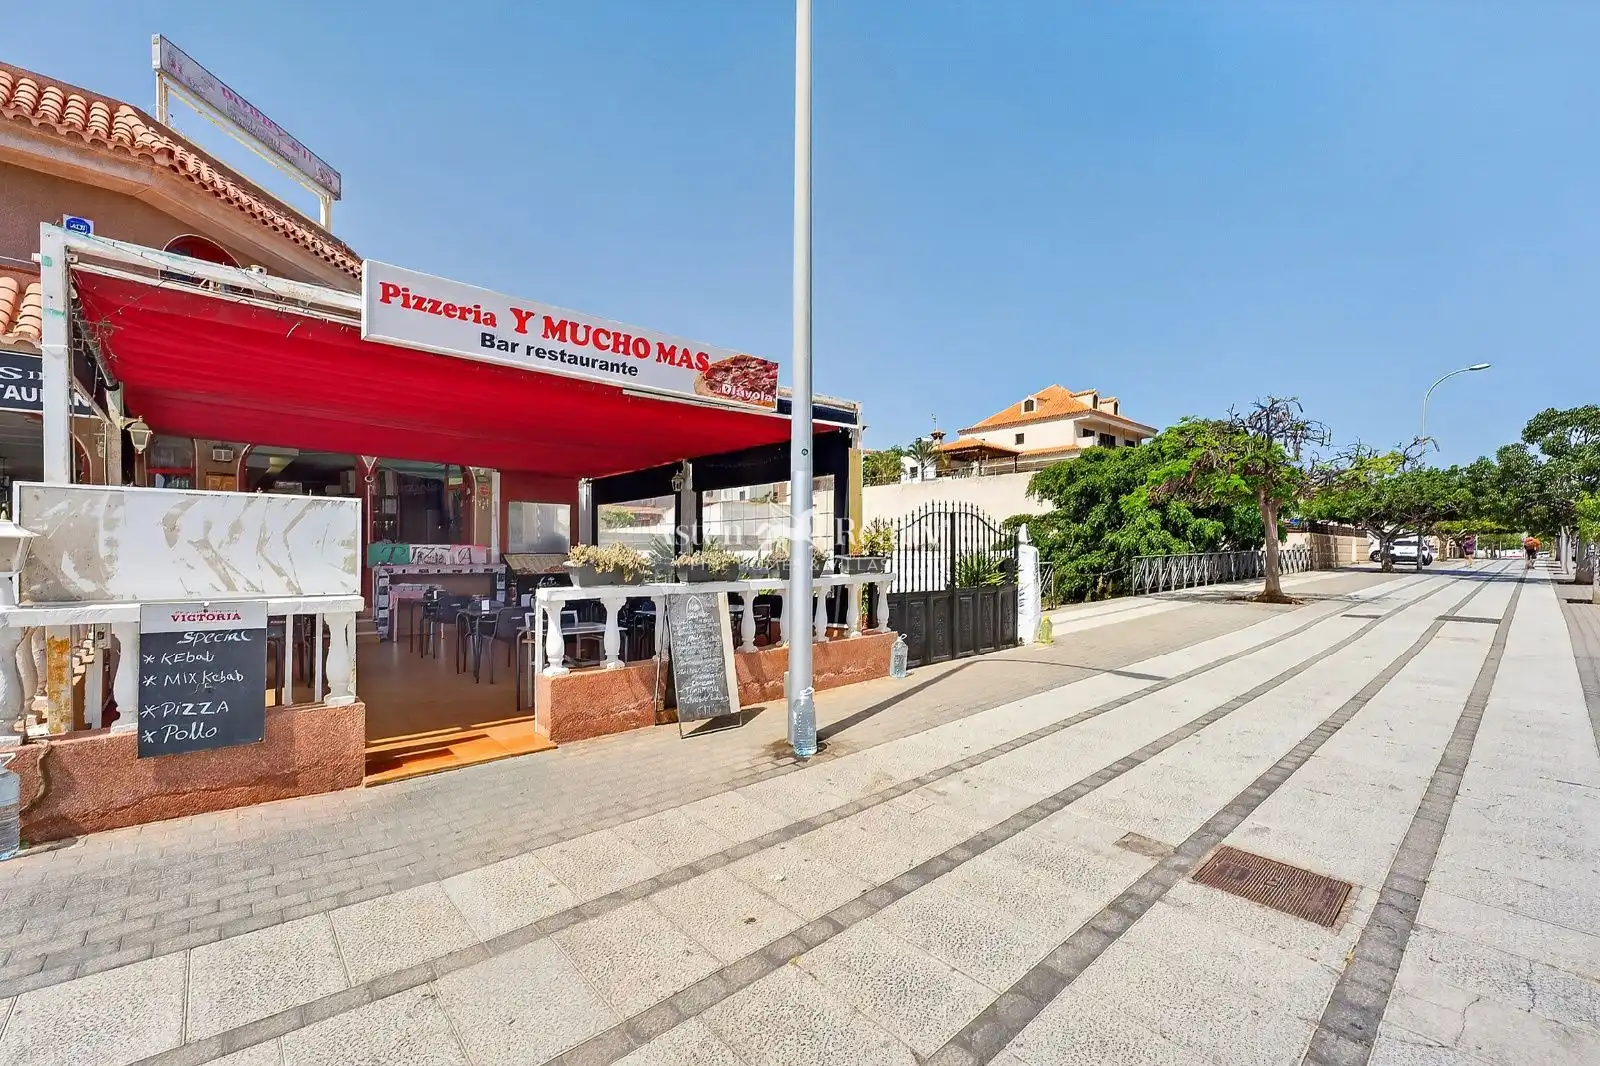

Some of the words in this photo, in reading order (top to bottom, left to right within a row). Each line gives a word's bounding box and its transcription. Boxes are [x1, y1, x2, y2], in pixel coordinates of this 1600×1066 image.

[379, 281, 497, 327] Pizzeria
[509, 307, 535, 334] Y
[541, 315, 651, 359] MUCHO
[656, 342, 711, 373] MAS
[480, 332, 520, 353] Bar
[526, 344, 638, 376] restaurante
[171, 612, 242, 622] VICTORIA
